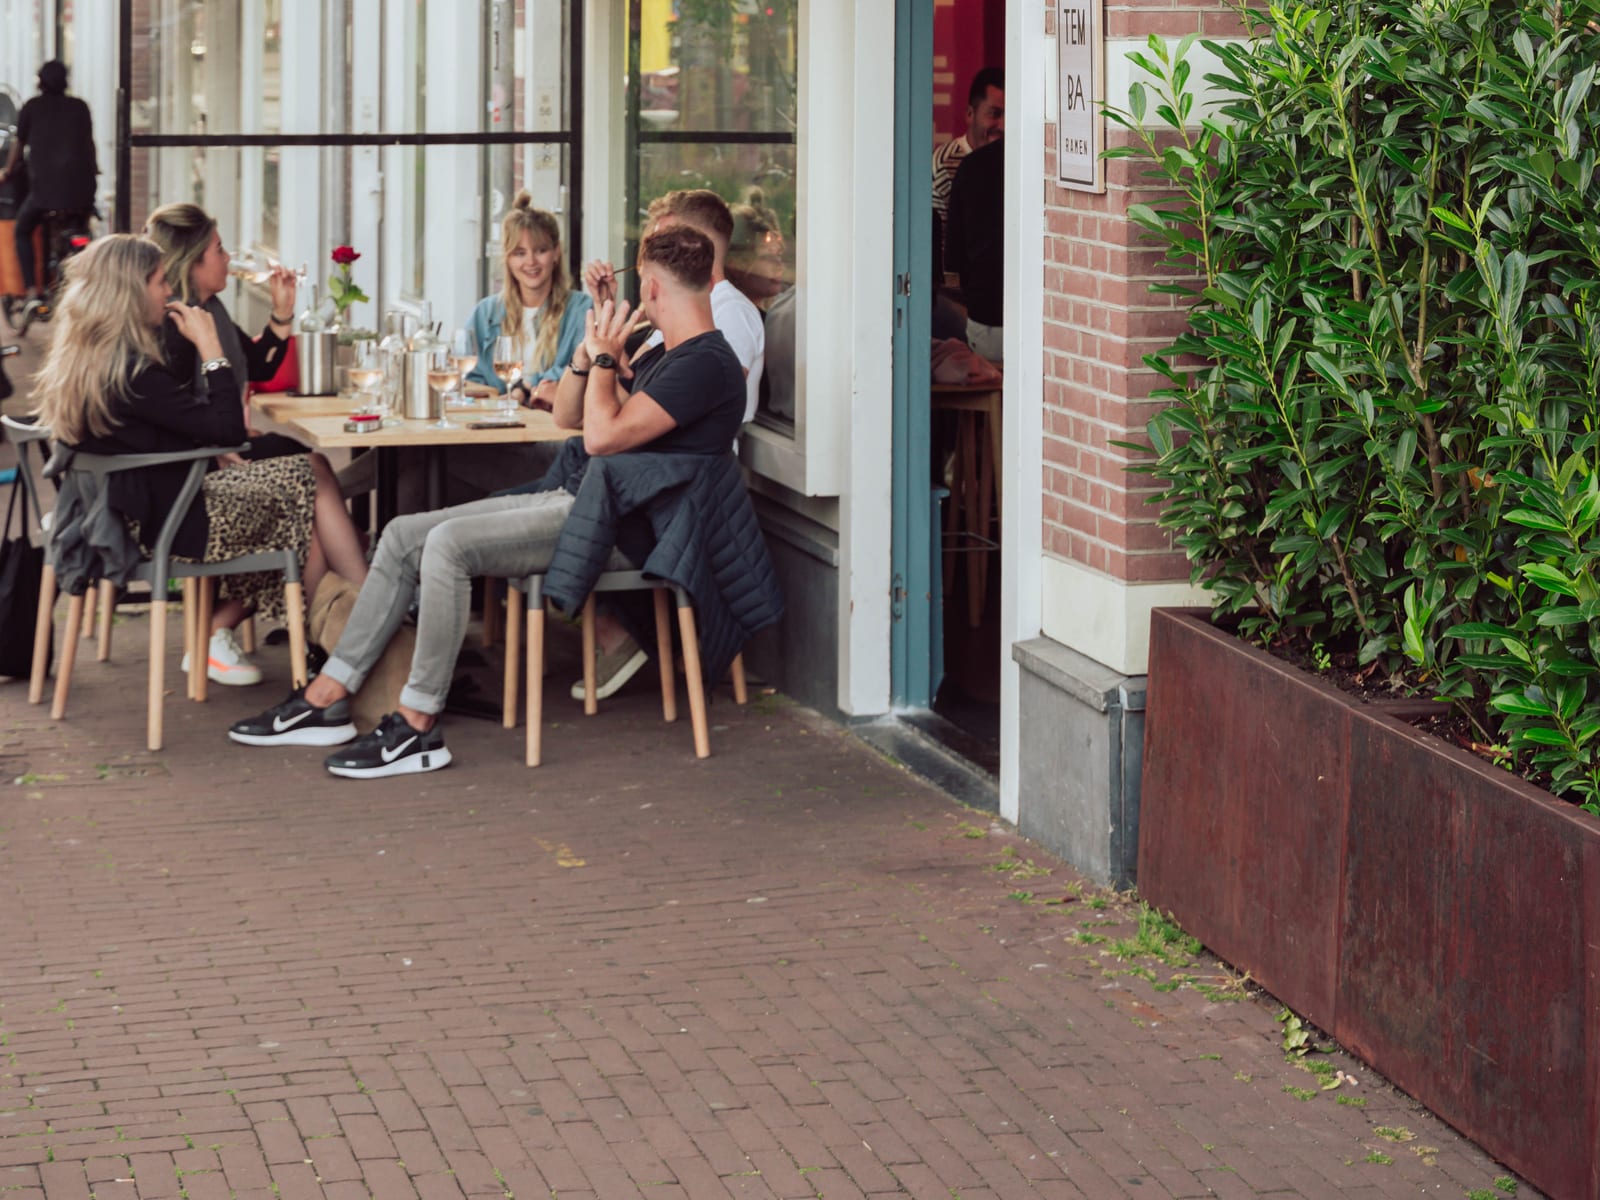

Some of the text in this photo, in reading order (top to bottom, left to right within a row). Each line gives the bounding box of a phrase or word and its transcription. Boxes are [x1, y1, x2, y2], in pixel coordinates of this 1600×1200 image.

[1063, 8, 1086, 46] TEM
[1067, 74, 1086, 111] BA
[1065, 138, 1088, 155] RAMEN
